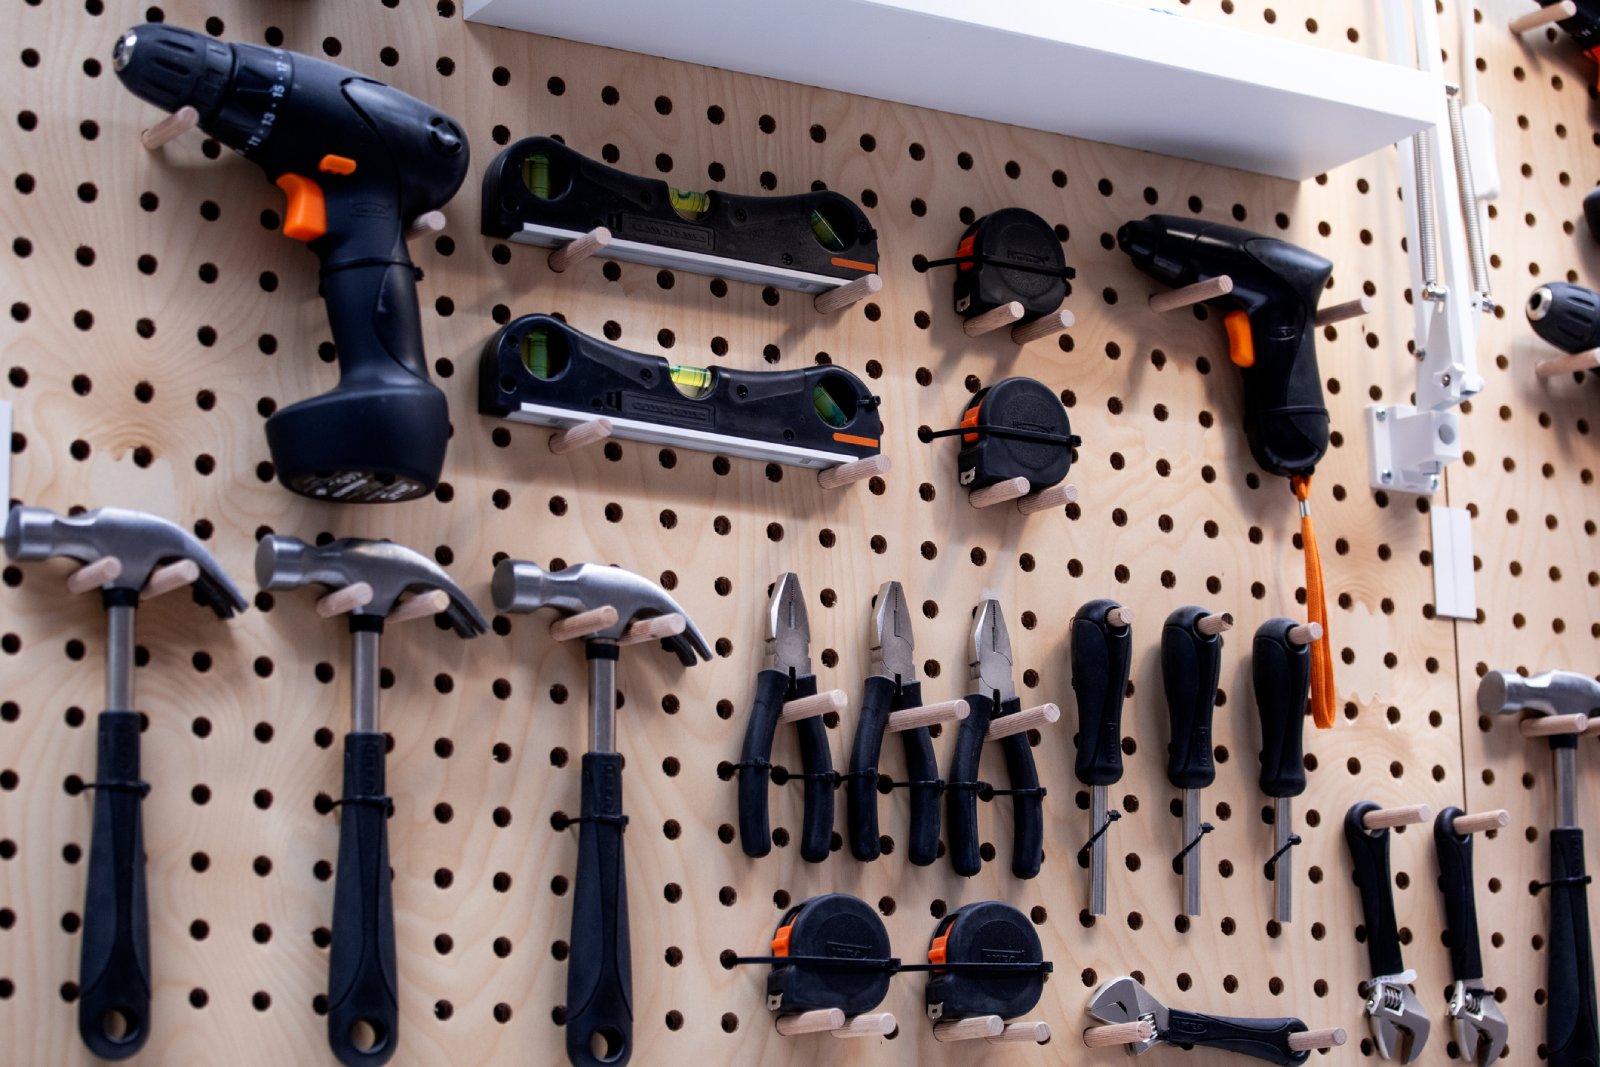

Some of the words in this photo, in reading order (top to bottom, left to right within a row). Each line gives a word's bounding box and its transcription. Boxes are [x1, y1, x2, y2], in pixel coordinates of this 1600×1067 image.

[276, 61, 289, 72] 17
[272, 84, 285, 98] 15
[261, 112, 275, 126] 13
[248, 136, 261, 146] 11
